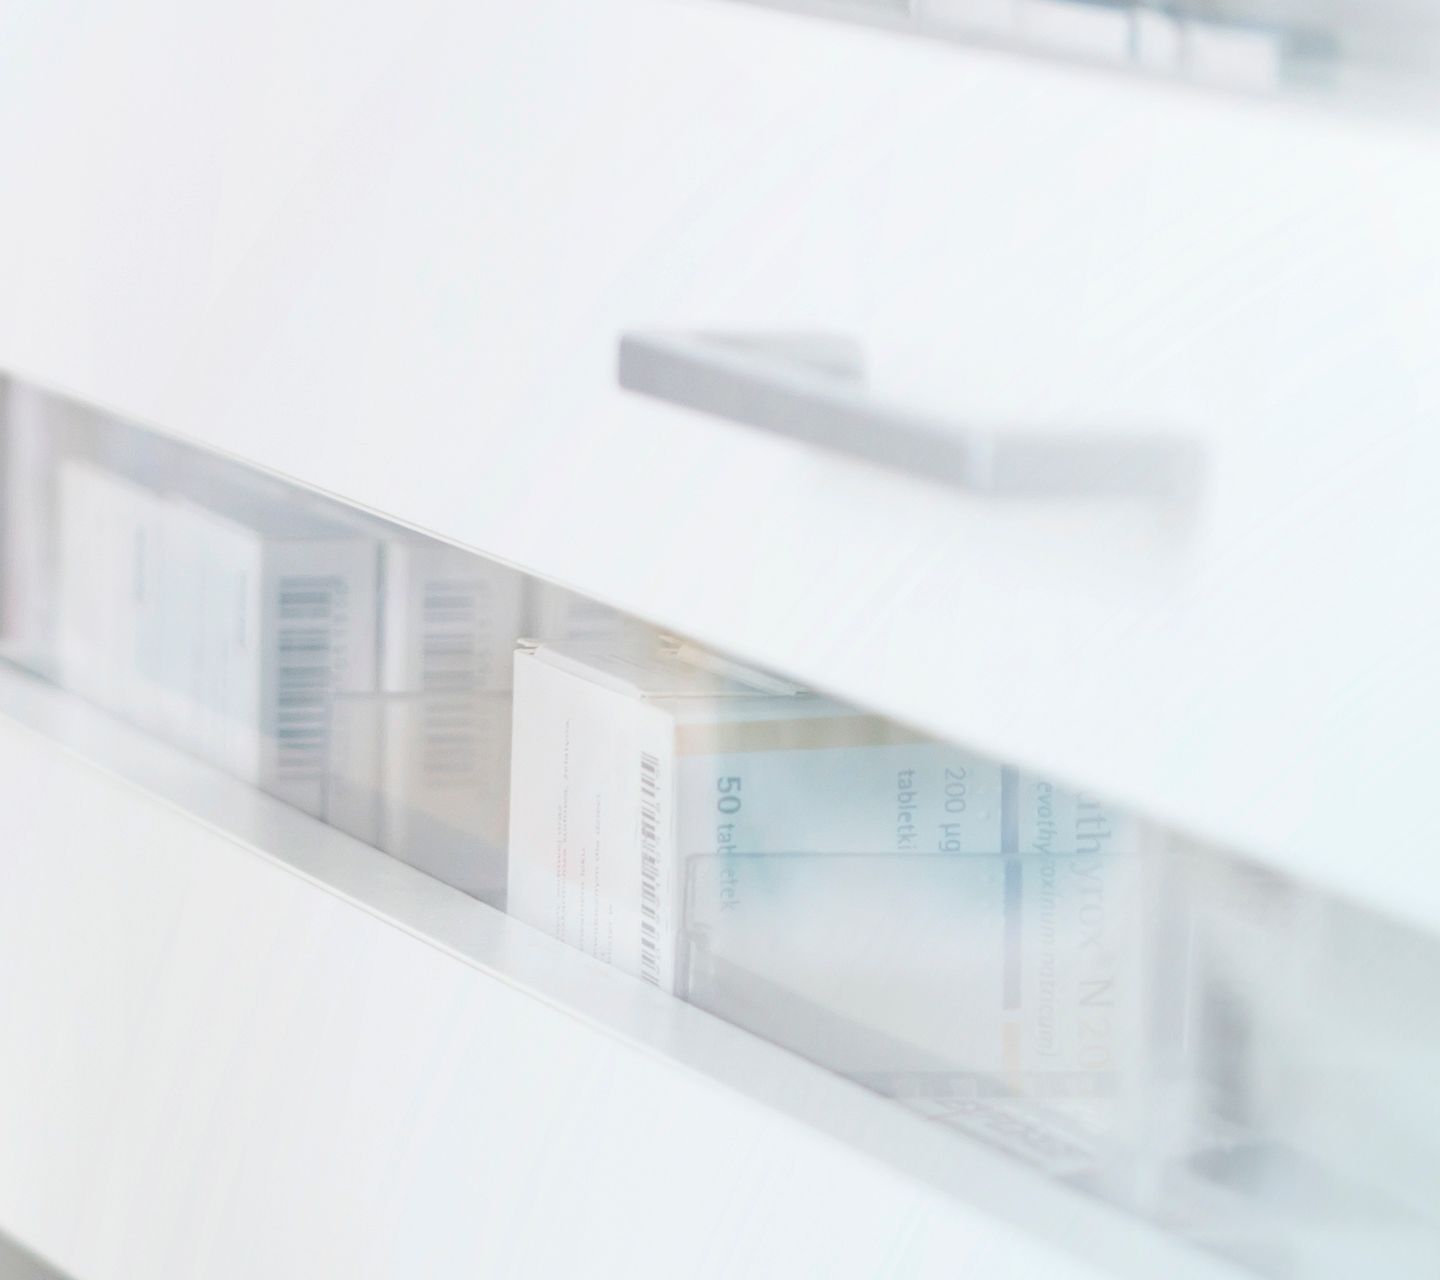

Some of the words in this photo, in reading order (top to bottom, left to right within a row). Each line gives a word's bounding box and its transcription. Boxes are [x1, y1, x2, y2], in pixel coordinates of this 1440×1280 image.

[717, 776, 741, 815] 50
[896, 768, 916, 850] tabletki
[944, 766, 966, 814] 200
[716, 823, 739, 913] tabetek
